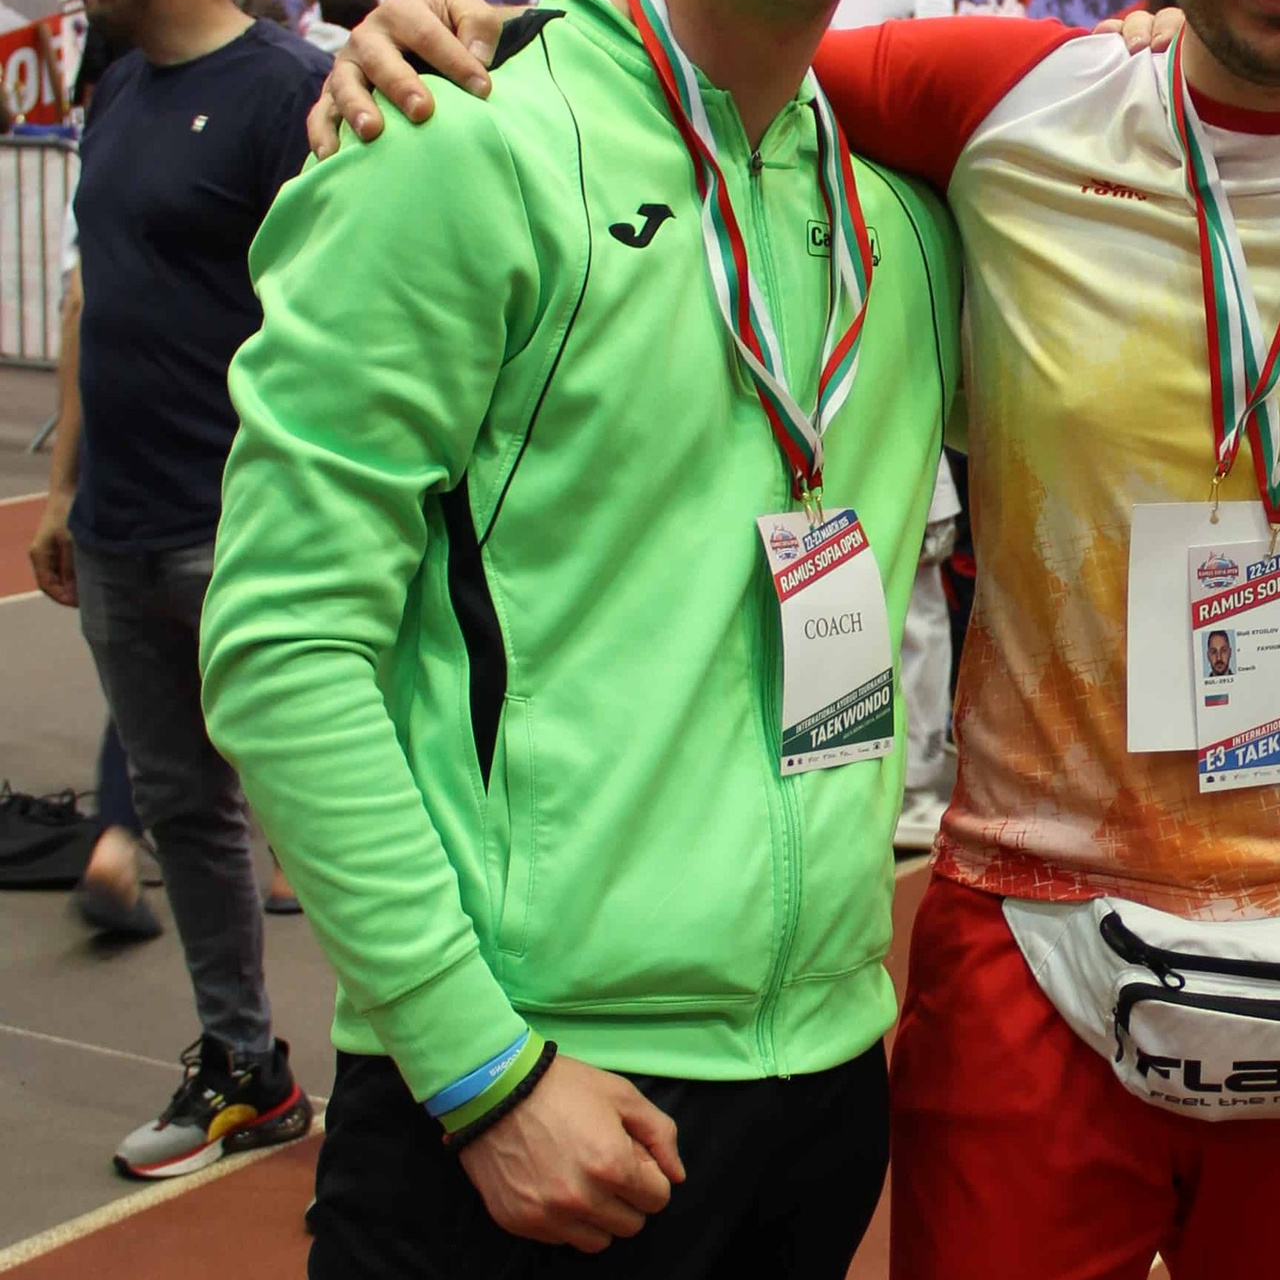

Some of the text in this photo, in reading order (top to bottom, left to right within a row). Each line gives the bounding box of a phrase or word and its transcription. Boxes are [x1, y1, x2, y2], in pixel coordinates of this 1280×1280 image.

[780, 562, 815, 593] RAMUS
[814, 545, 843, 571] SOFIA
[840, 528, 864, 554] OPEN
[1249, 559, 1277, 579] 22-23
[1199, 588, 1254, 621] RAMUS
[804, 612, 863, 640] COACH
[795, 703, 836, 734] INTERNATIONAL
[858, 671, 890, 699] TOURNAMENT
[810, 685, 890, 748] TAEKWONDO
[1205, 745, 1226, 771] E3
